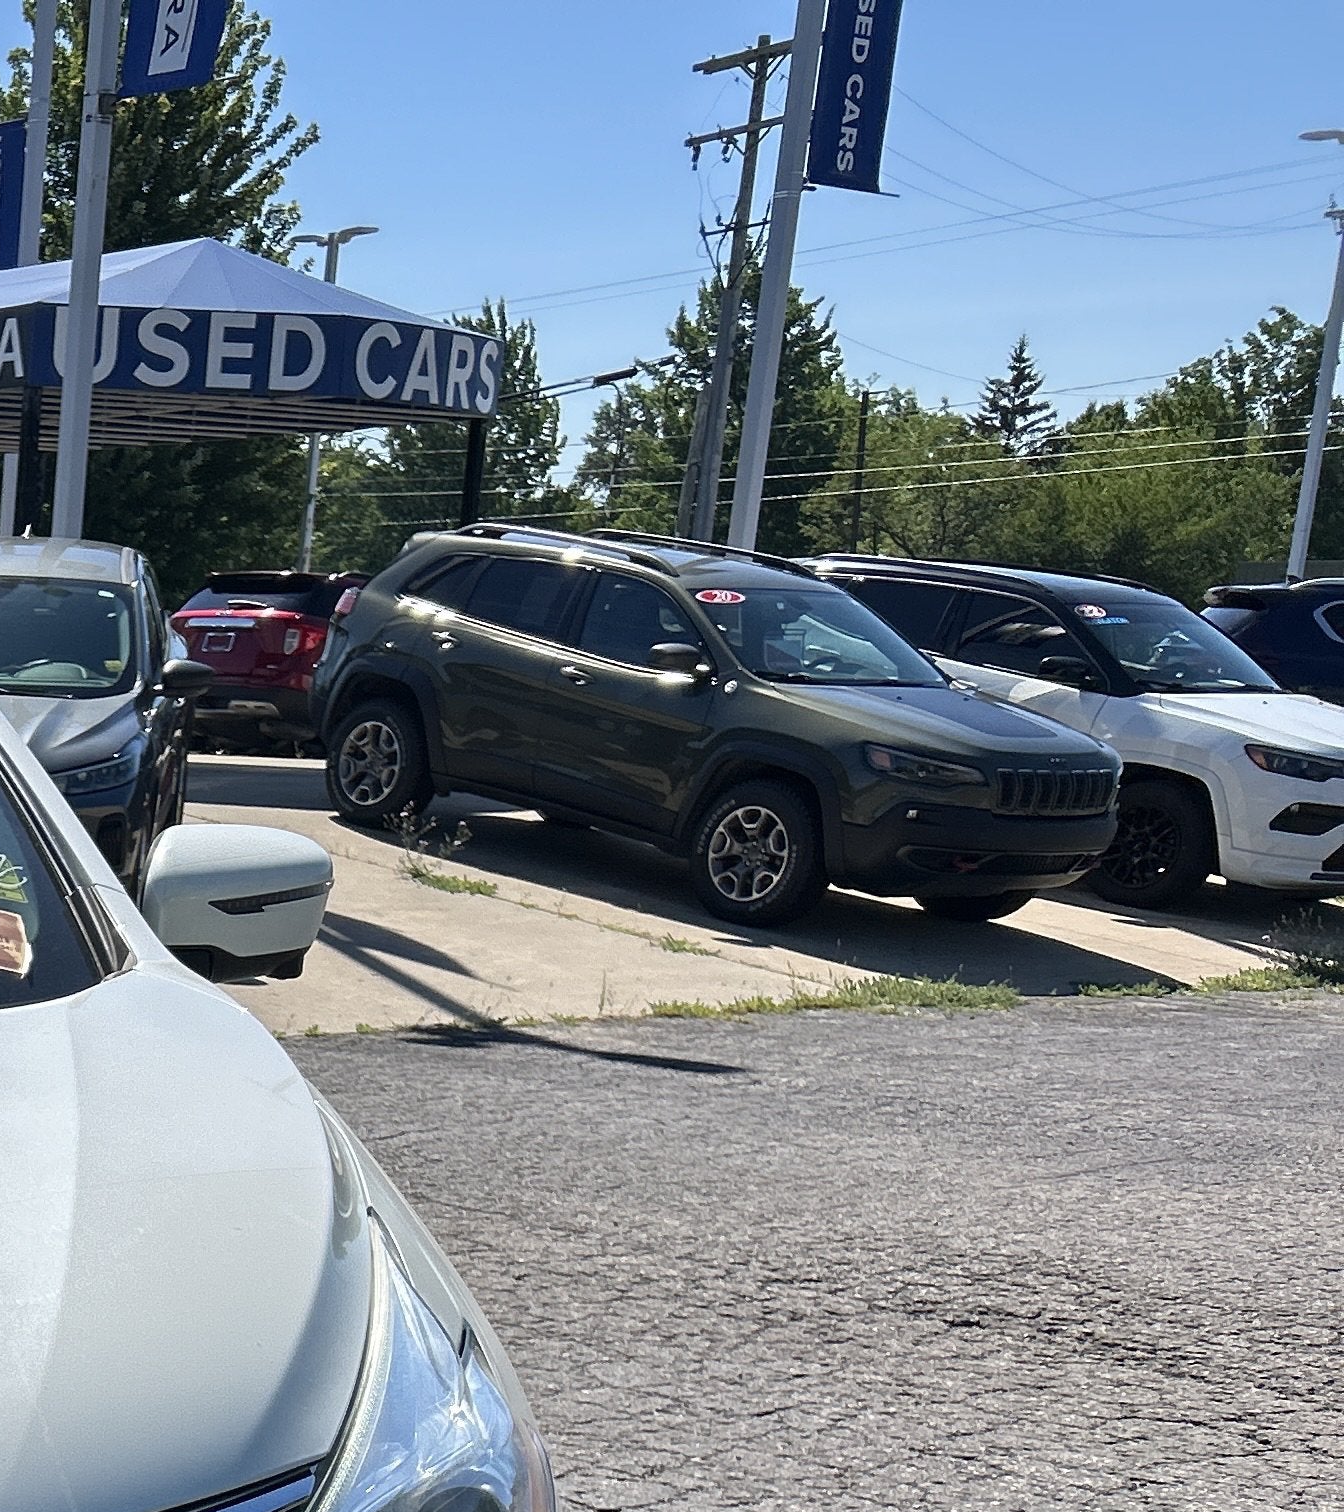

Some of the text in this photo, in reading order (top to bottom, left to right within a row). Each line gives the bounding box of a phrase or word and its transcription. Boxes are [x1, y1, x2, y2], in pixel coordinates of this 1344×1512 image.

[837, 0, 877, 171] SED CARS
[53, 306, 500, 414] USED CARS
